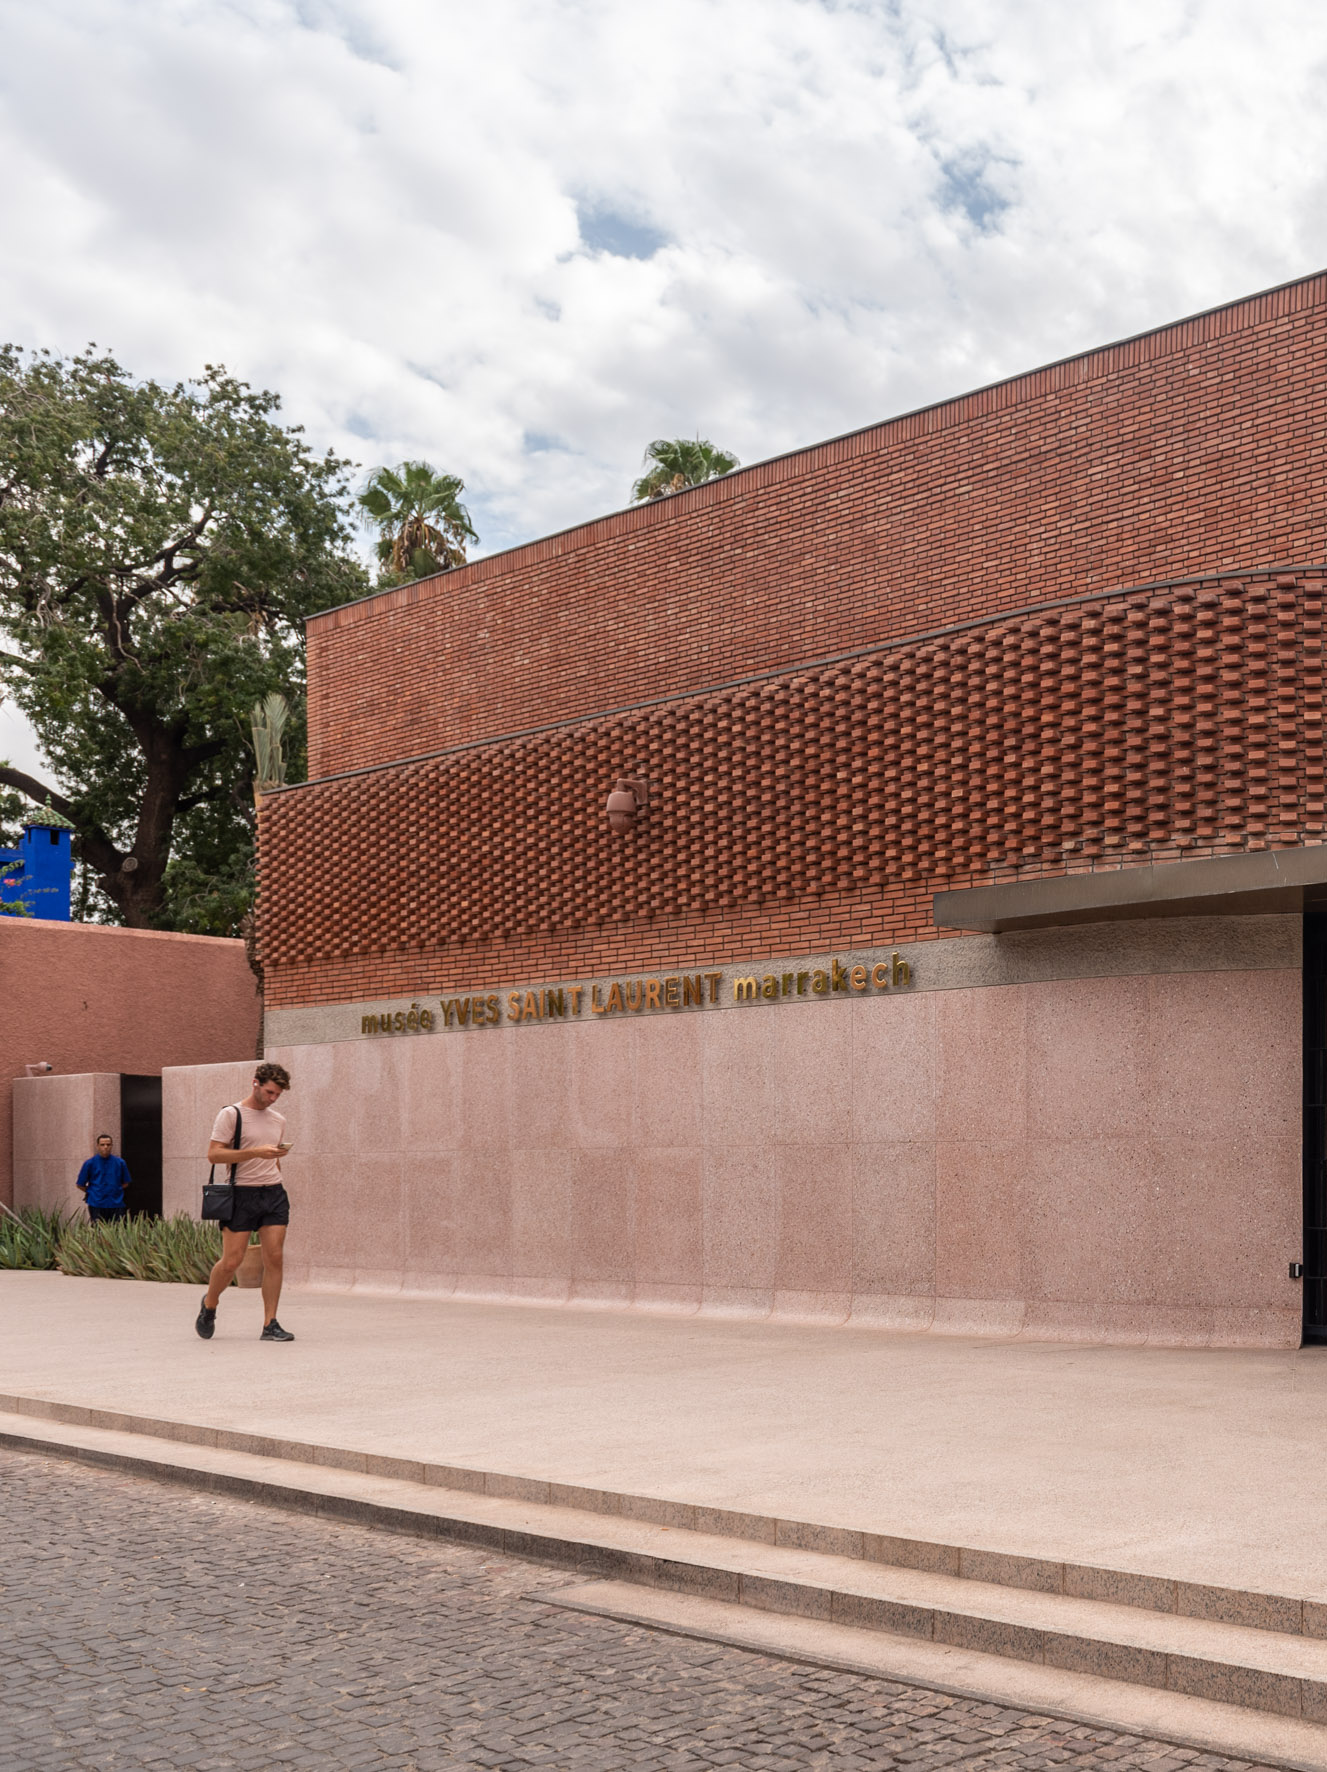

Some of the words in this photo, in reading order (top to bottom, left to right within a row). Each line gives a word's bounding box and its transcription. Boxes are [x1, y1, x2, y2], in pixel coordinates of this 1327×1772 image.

[361, 1002, 432, 1034] musée
[440, 993, 499, 1027] YVES
[507, 985, 583, 1021] SAINT
[591, 972, 722, 1013] LAURENT
[733, 952, 910, 1001] marrakech
